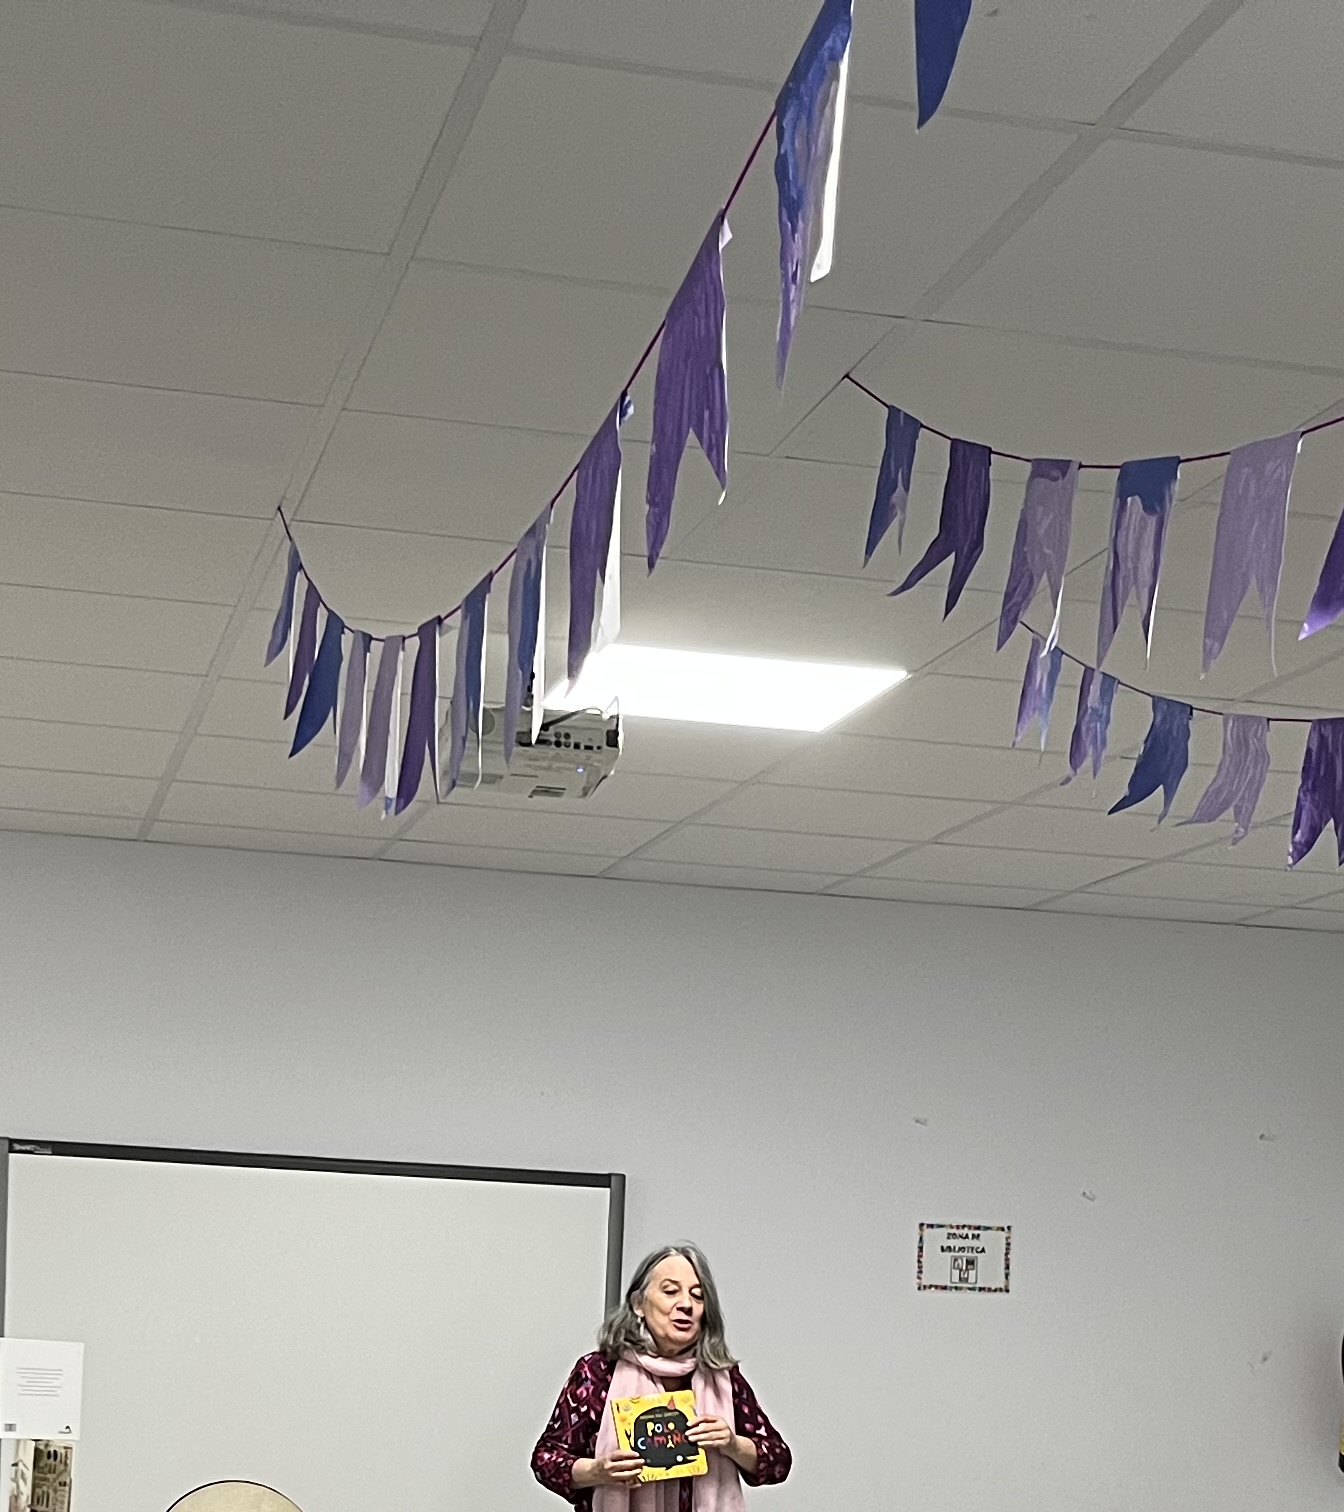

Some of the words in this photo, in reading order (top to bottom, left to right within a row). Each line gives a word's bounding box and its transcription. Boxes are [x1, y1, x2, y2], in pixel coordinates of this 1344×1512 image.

[946, 1232, 969, 1240] ZONA
[971, 1233, 981, 1241] DE
[940, 1245, 986, 1254] BIBLIOTECA
